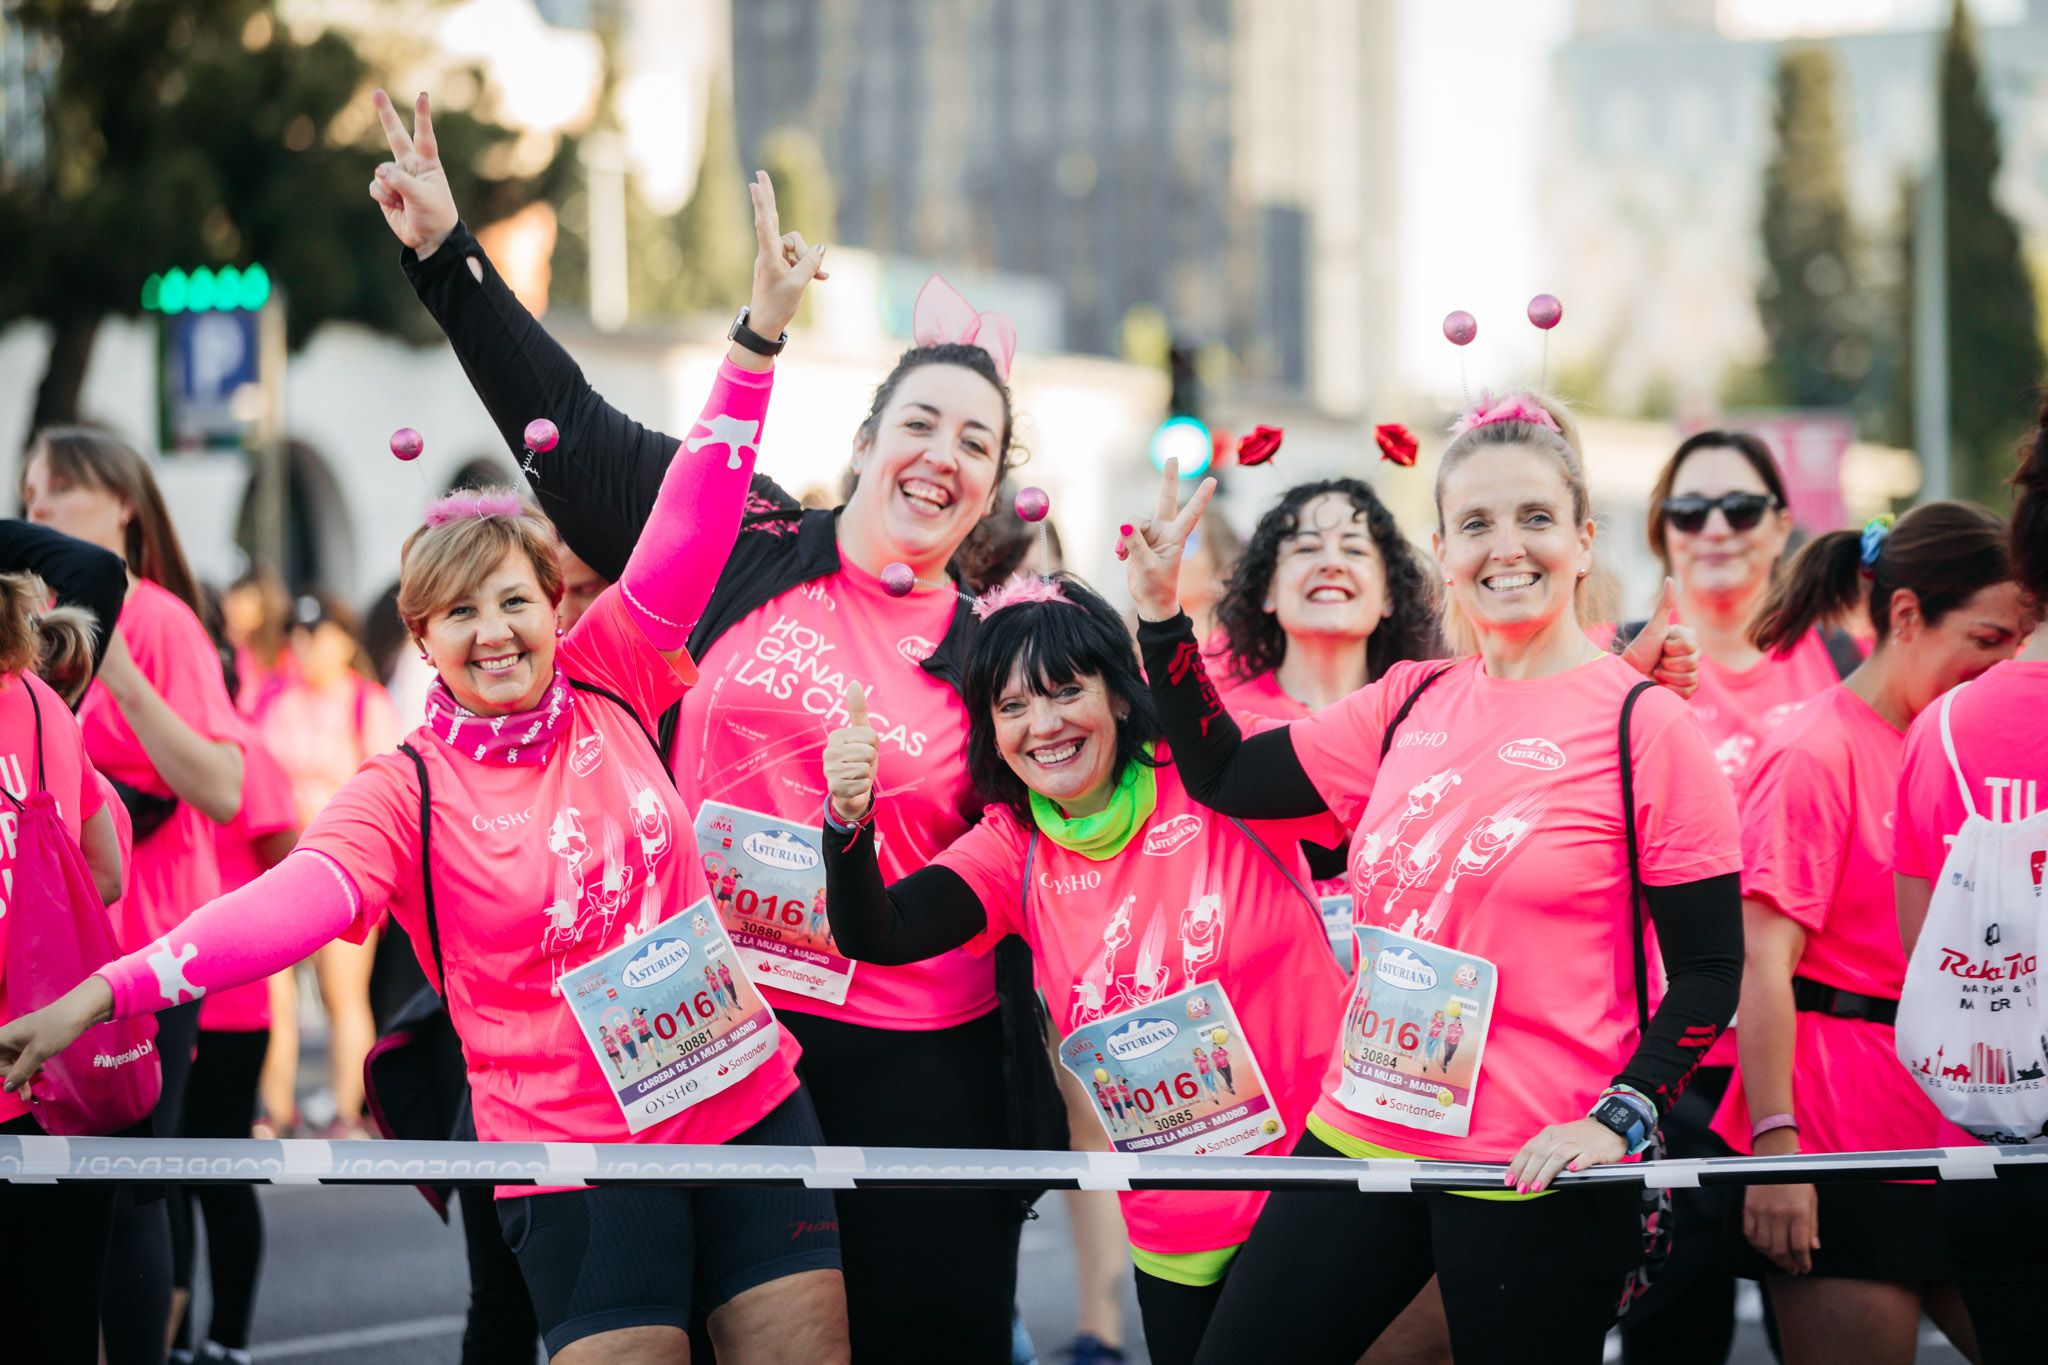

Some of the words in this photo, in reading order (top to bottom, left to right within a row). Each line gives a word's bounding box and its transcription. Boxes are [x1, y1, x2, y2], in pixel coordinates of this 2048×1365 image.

[768, 614, 837, 657] HOY
[734, 659, 799, 700] LAS
[801, 687, 928, 757] CHCAS
[1396, 730, 1448, 749] OYSHO
[746, 837, 813, 867] ASTURIANA
[1147, 822, 1199, 852] ASTURIANA
[735, 889, 805, 926] 016
[741, 921, 782, 940] 30880
[743, 935, 755, 946] LA
[757, 938, 788, 955] MUJER
[794, 948, 830, 965] MADRID
[628, 946, 689, 987] ASTURIANA
[773, 964, 827, 987] Santander
[1378, 957, 1432, 986] ASTURIANA
[653, 990, 715, 1041] 016
[1361, 1009, 1421, 1051] 016
[637, 1068, 676, 1094] CARRERA
[675, 1062, 689, 1074] DE
[688, 1054, 701, 1067] LA
[700, 1038, 729, 1061] MUJER
[729, 1020, 758, 1042] MADRID
[677, 1028, 714, 1056] 30881
[1109, 1027, 1175, 1057] ASTURIANA
[1361, 1047, 1398, 1069] 30884
[645, 1079, 698, 1114] OYSHO
[728, 1040, 768, 1071] Santander
[1362, 1064, 1373, 1077] LA
[1373, 1069, 1403, 1086] MUJER
[1409, 1079, 1446, 1095] MADRI
[1133, 1072, 1199, 1114] 016
[1154, 1108, 1193, 1131] 30885
[1165, 1131, 1178, 1143] LA
[1178, 1120, 1208, 1139] MUJER
[1211, 1105, 1249, 1126] MADRID
[1389, 1098, 1447, 1121] Santander
[1206, 1125, 1260, 1153] Santander
